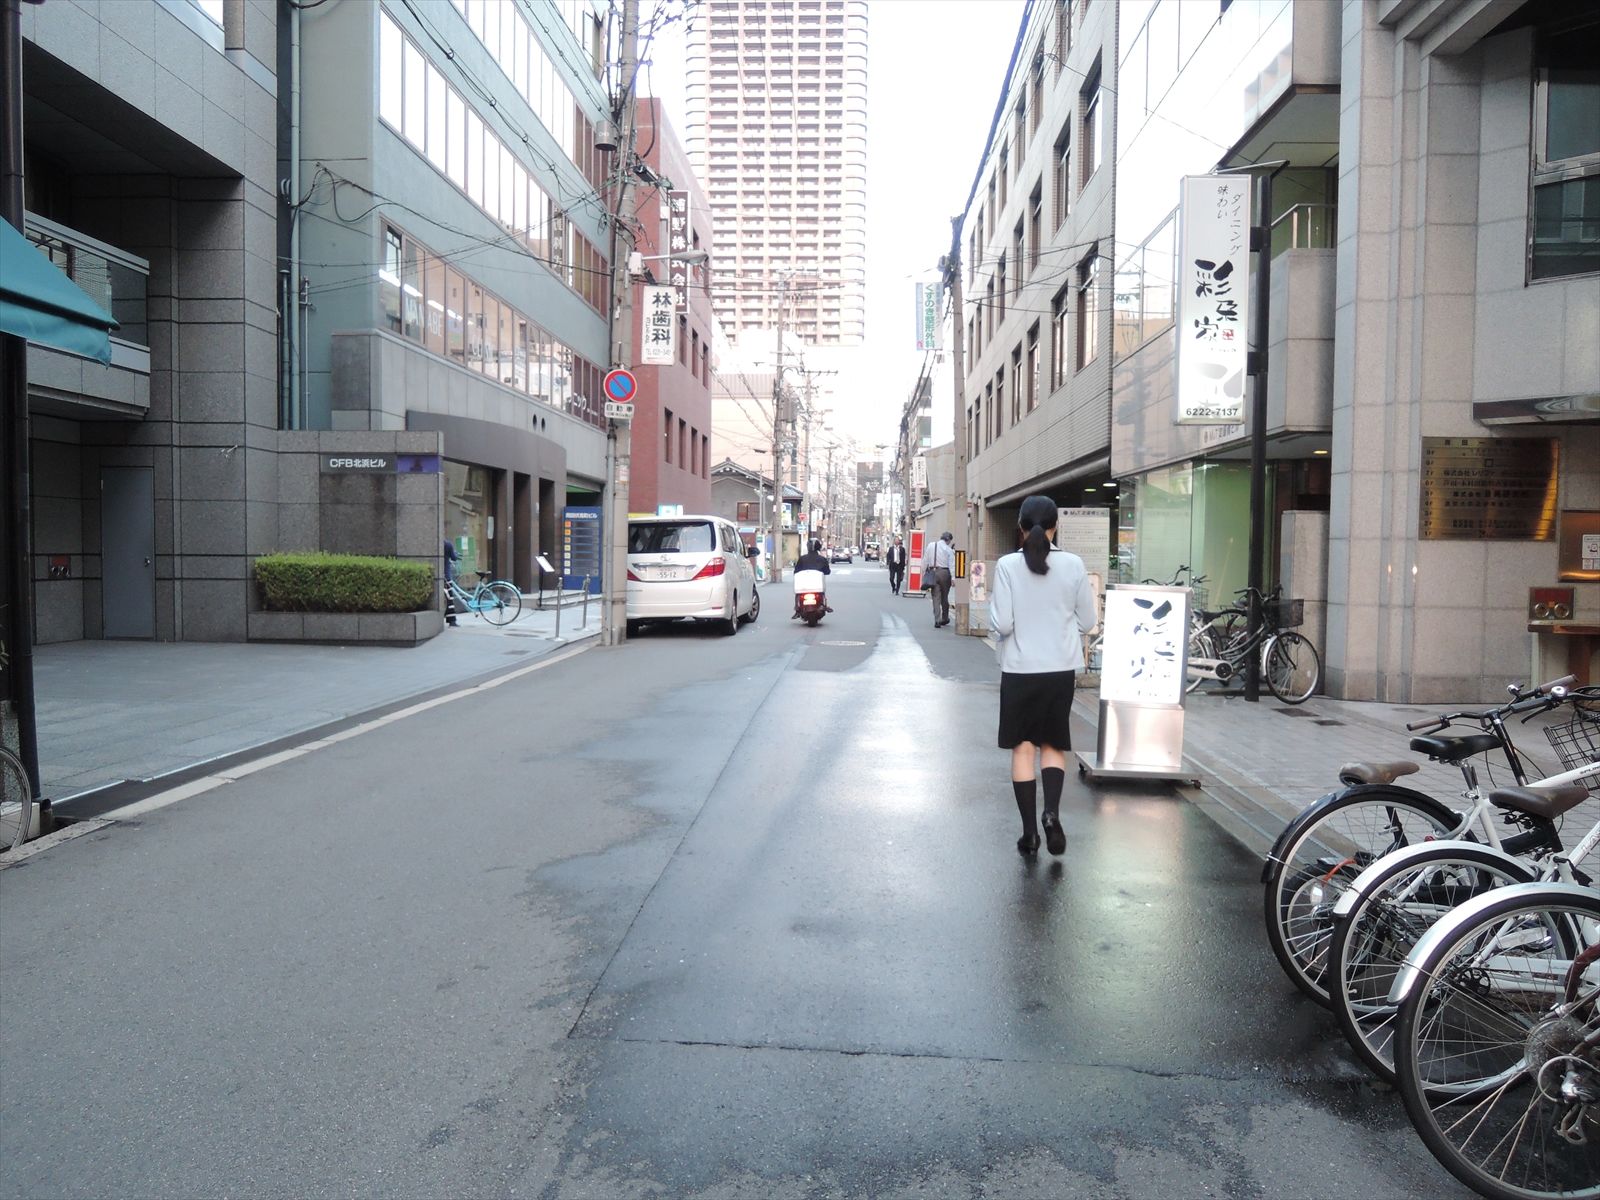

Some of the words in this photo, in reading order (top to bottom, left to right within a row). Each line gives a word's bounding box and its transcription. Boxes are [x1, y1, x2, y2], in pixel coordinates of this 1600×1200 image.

[1230, 193, 1243, 255] ダイニング
[652, 291, 672, 345] 林歯科
[1186, 408, 1239, 416] 6222-7137
[329, 458, 386, 468] CFB北浜ビル
